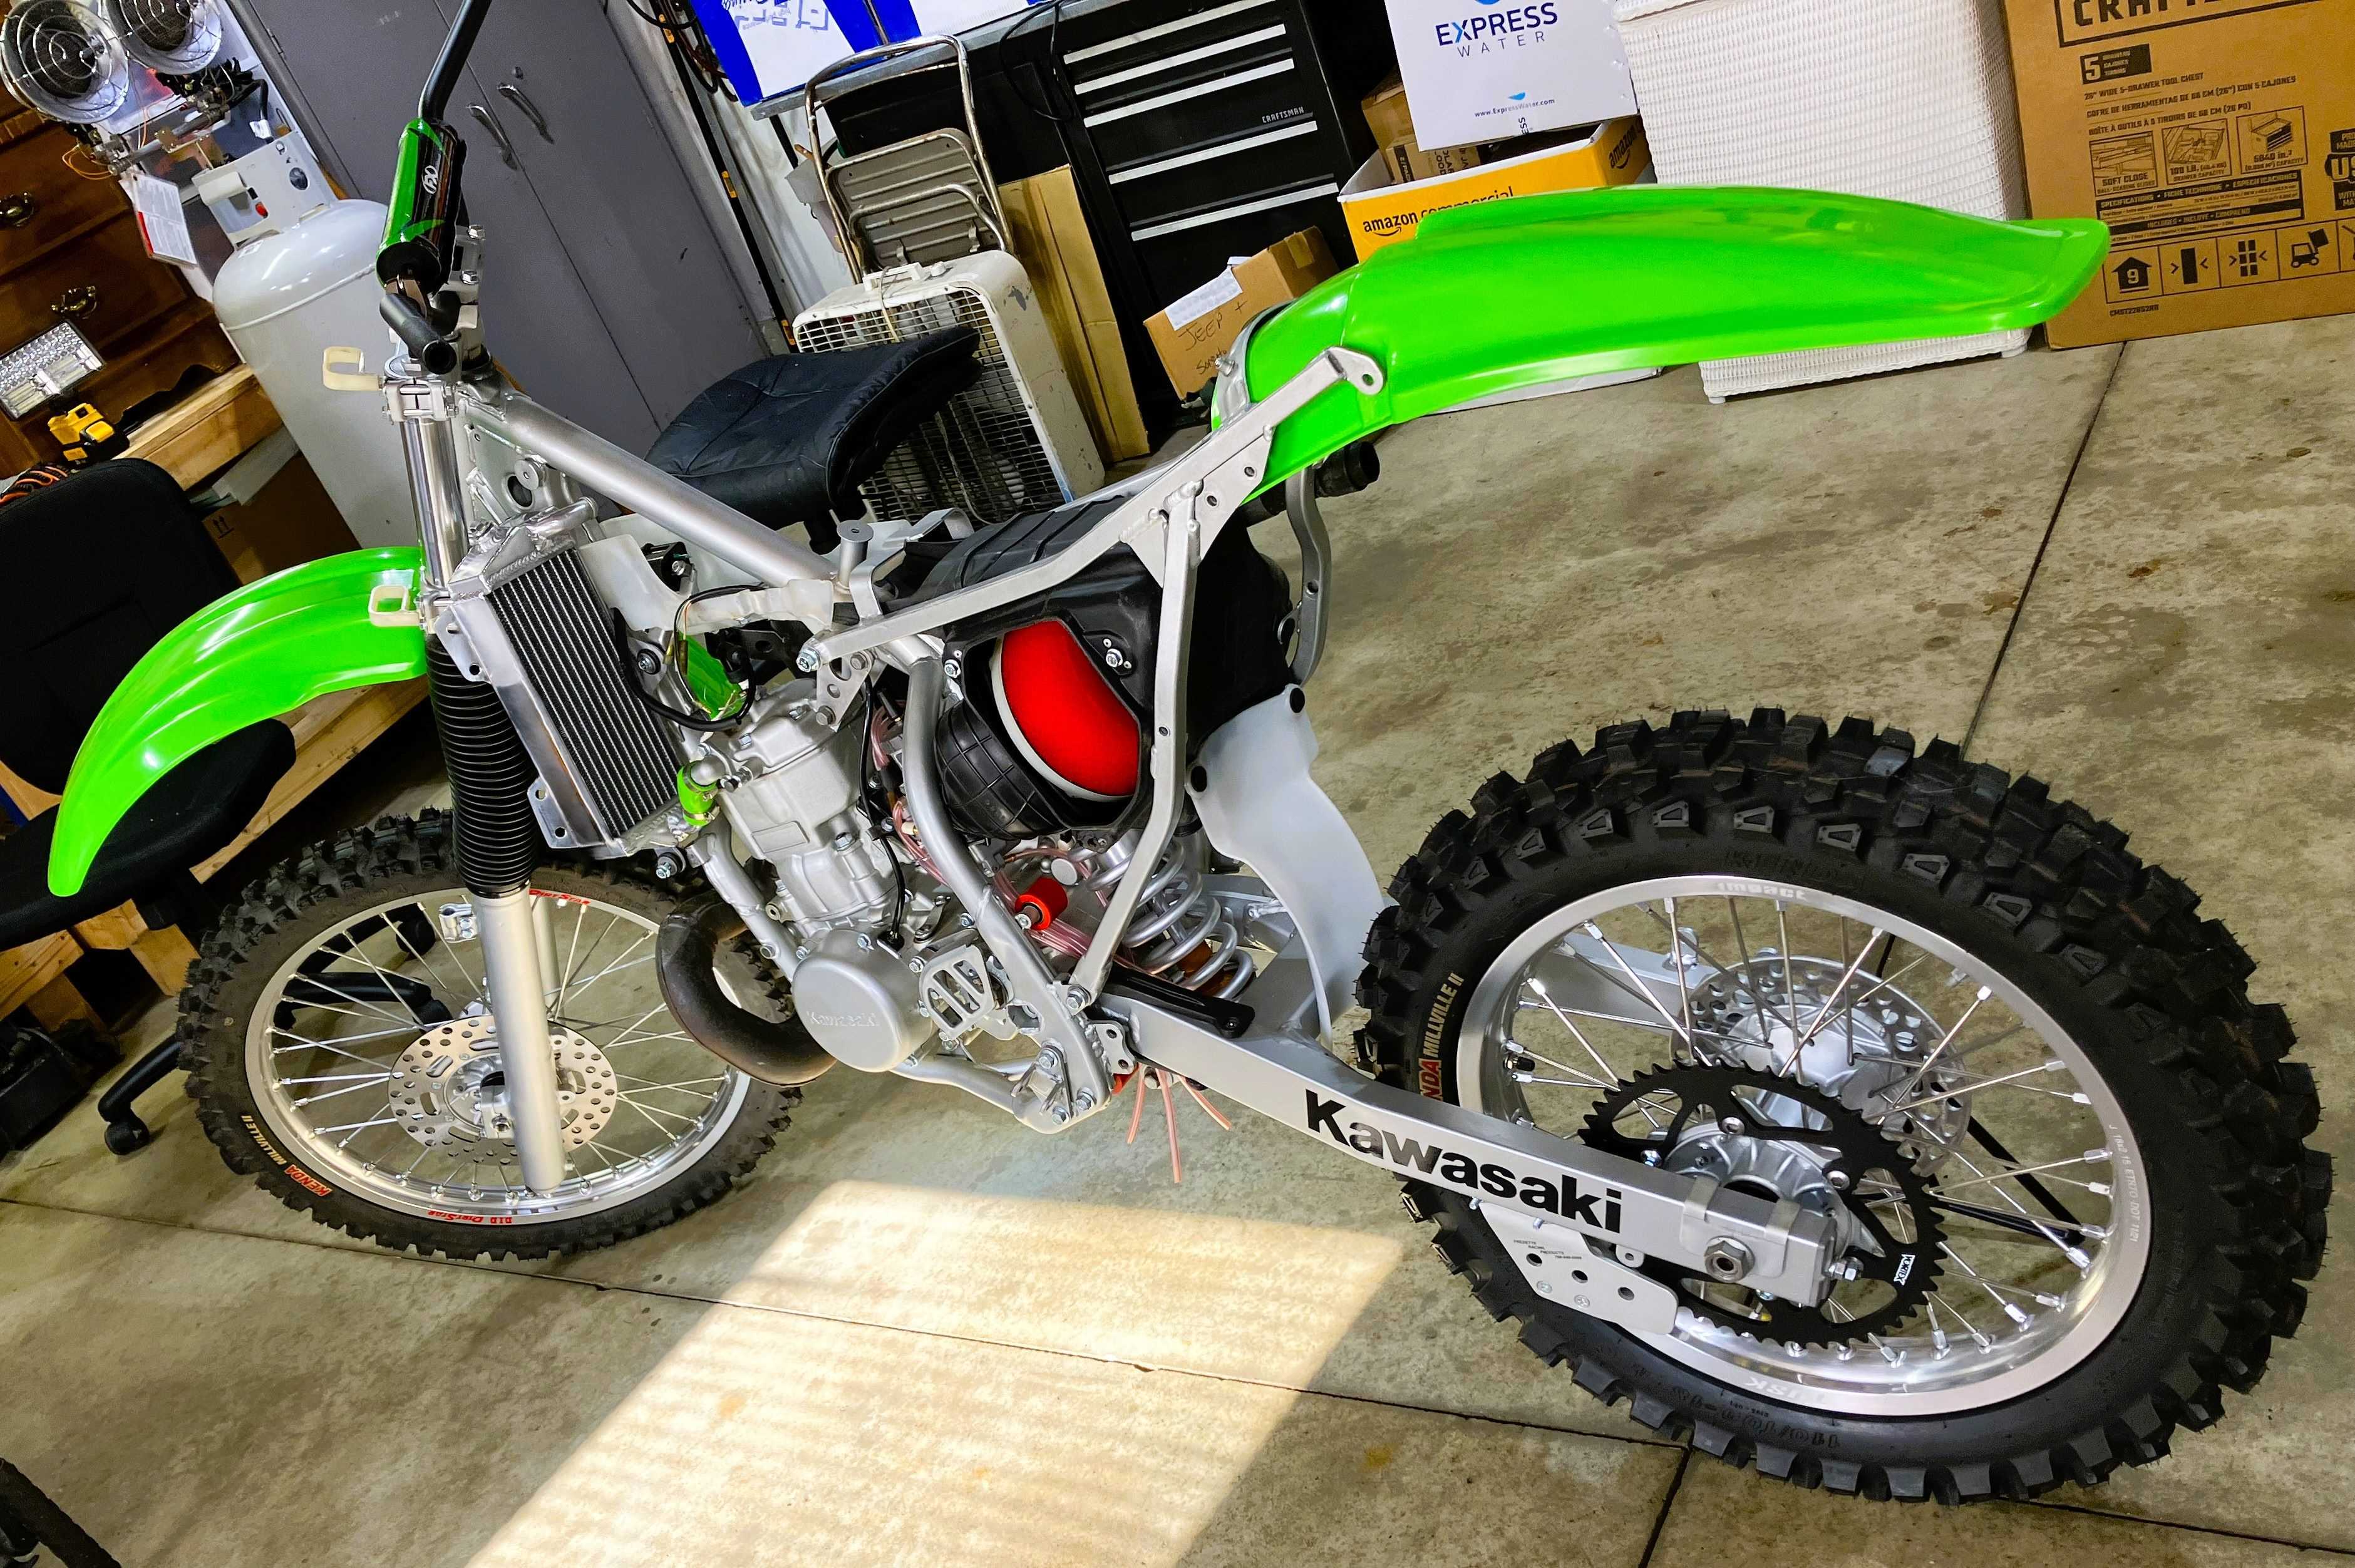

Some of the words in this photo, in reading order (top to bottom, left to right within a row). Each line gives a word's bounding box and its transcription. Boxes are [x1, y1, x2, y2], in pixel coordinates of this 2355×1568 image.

[1435, 3, 1558, 46] EXPRESS
[1456, 31, 1545, 58] WATER
[2084, 56, 2101, 80] 5
[2087, 108, 2110, 118] COFRE
[2122, 96, 2178, 112] HERRAMIENTAS
[2202, 90, 2213, 98] CM
[2237, 82, 2254, 91] CON
[2261, 75, 2296, 88] CAJONES
[2099, 88, 2118, 97] WIDE
[2120, 80, 2160, 93] 5-DRAWER
[2162, 78, 2178, 86] TOOL
[2180, 72, 2204, 83] CHEST
[1262, 106, 1304, 123] CRAFTSMAN
[1475, 98, 1555, 118] www.ExpressWater.com
[2118, 120, 2142, 131] OUTILS
[2157, 113, 2185, 123] TIROIRS
[2210, 106, 2222, 115] CM
[2102, 176, 2121, 187] SOFT
[2123, 172, 2149, 183] CLOSE
[1362, 211, 1419, 233] amazon
[2126, 268, 2139, 284] 9
[1177, 313, 1224, 351] JEEP
[1423, 983, 1458, 1058] MILLVILLE
[245, 1122, 287, 1165] MILLVILLE
[1306, 1088, 1622, 1234] Kawasaki
[284, 1163, 332, 1197] KENDA
